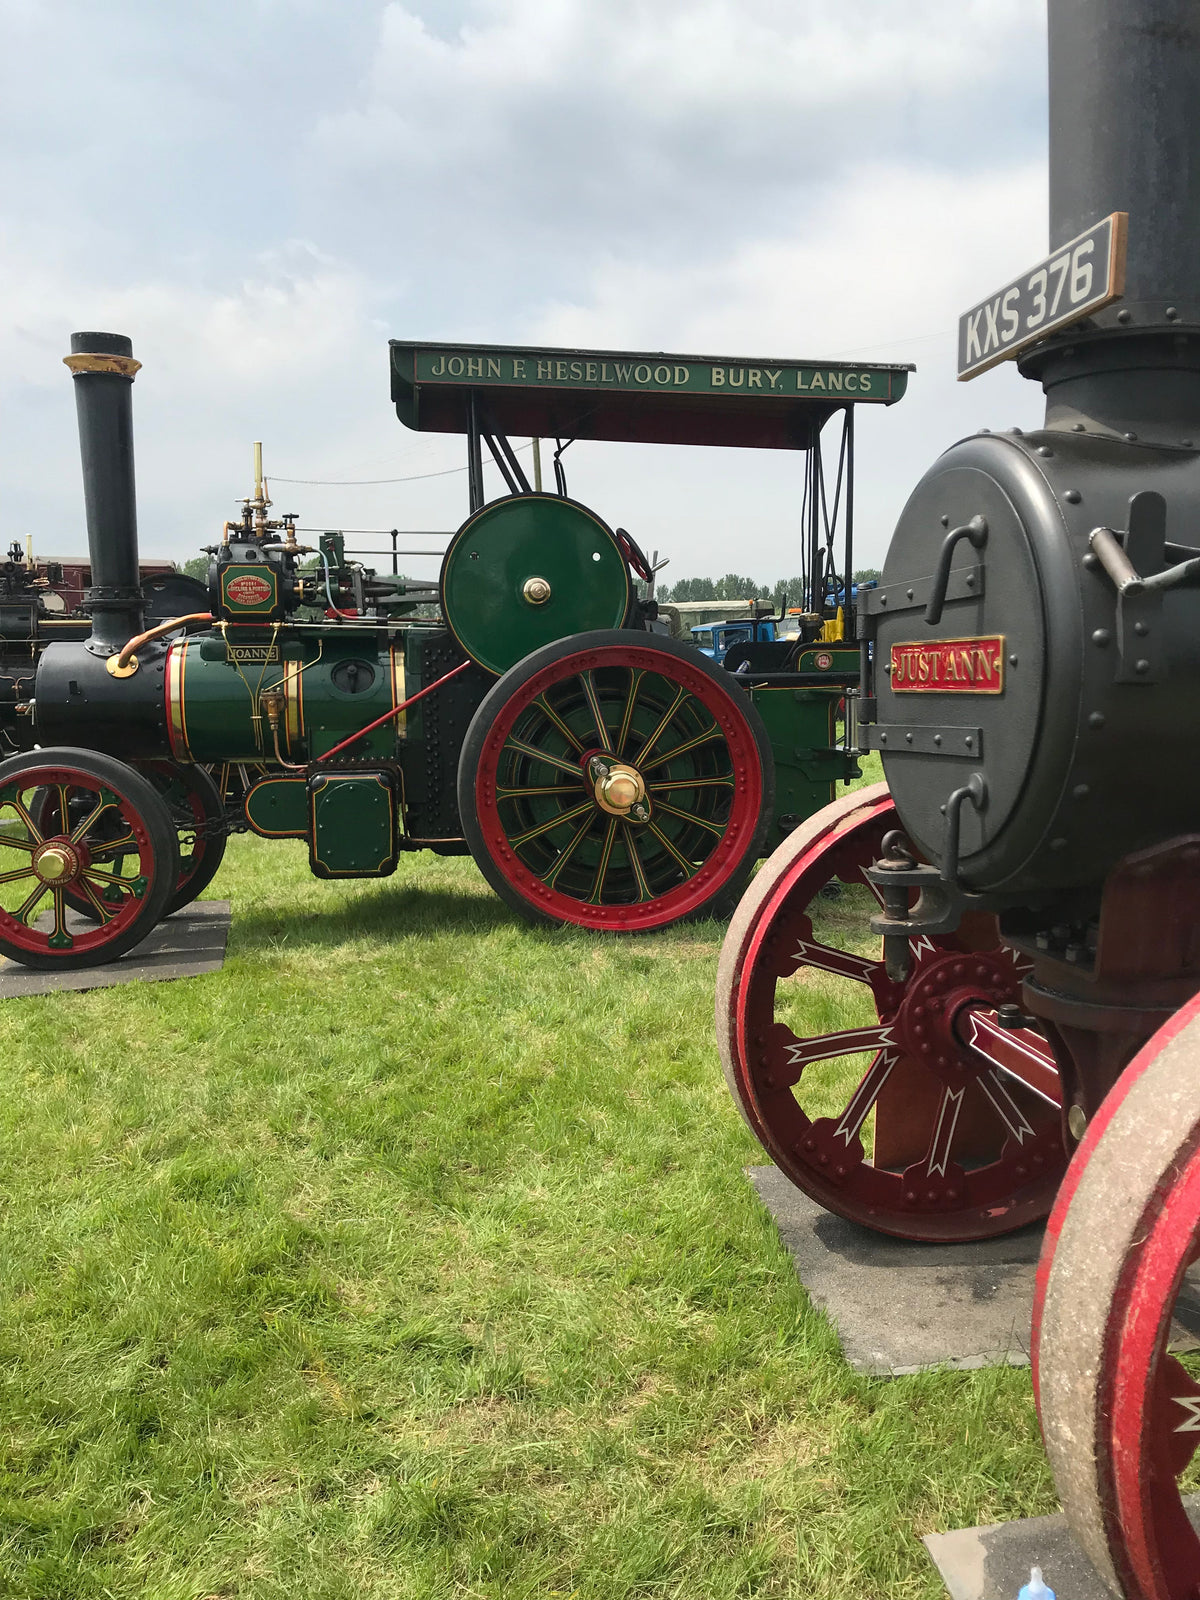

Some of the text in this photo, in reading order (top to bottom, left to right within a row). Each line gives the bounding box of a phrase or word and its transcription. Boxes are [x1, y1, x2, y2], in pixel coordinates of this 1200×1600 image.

[966, 239, 1095, 364] KXS 376
[431, 356, 872, 392] JOHN F. HESELWOOD BURY, LANCS
[230, 648, 276, 659] JOANNE
[897, 651, 941, 682] JUST
[944, 649, 994, 681] ANN
